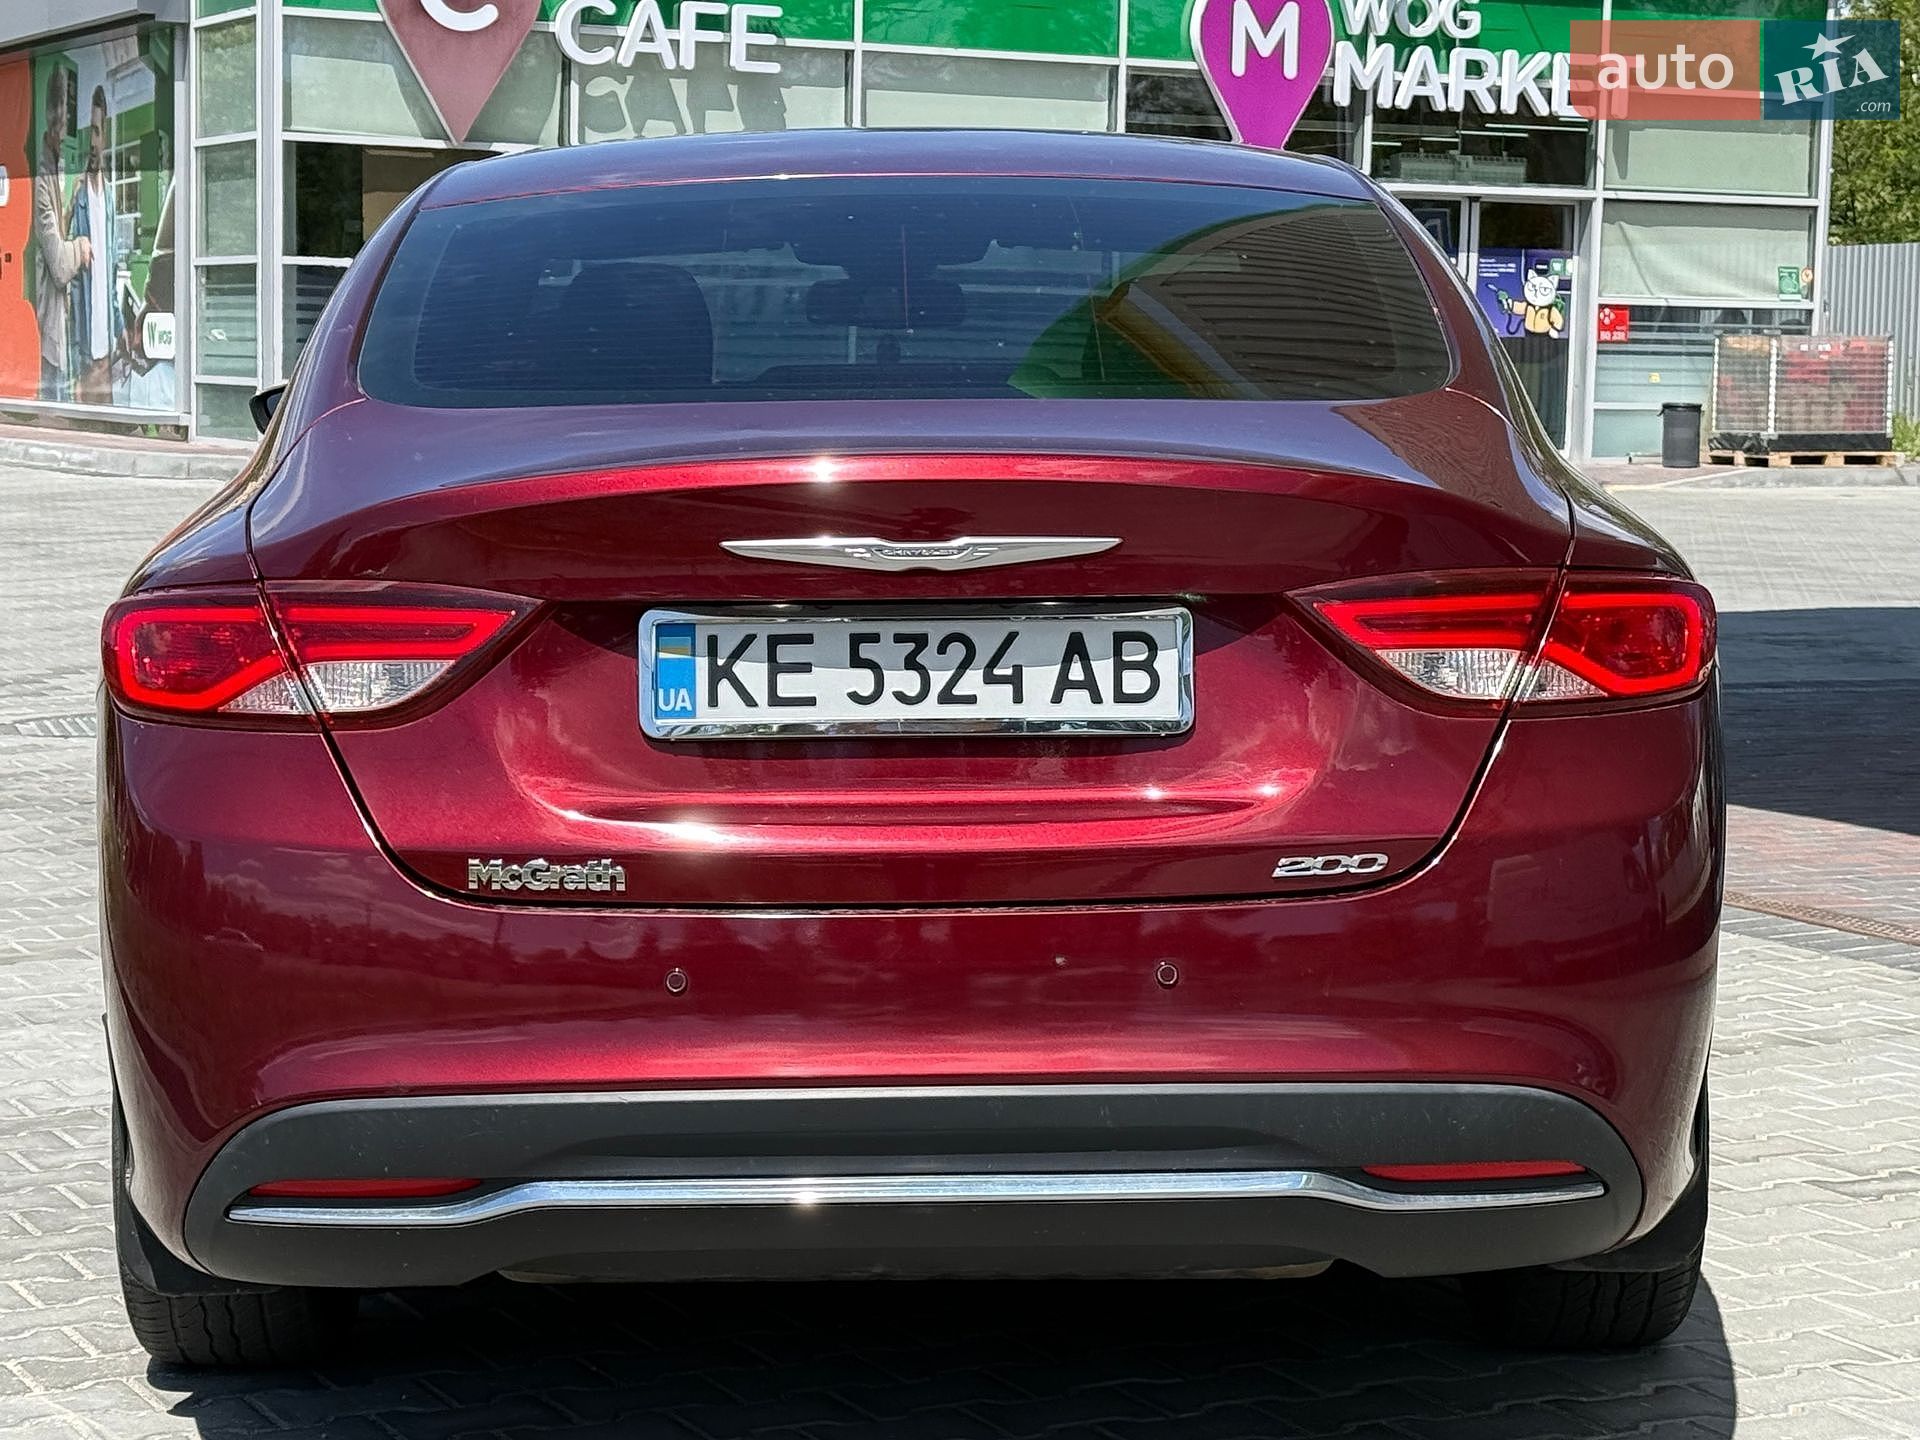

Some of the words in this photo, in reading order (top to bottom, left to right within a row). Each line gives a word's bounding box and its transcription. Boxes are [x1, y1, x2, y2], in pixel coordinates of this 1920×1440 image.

[553, 0, 785, 74] CAFE
[1340, 0, 1482, 38] WOG
[1231, 0, 1299, 80] M
[706, 632, 818, 709] KE
[845, 630, 1024, 706] 5324
[1050, 630, 1161, 705] AB
[657, 687, 694, 712] UA
[467, 857, 627, 892] McGrath
[1271, 853, 1389, 878] 200
